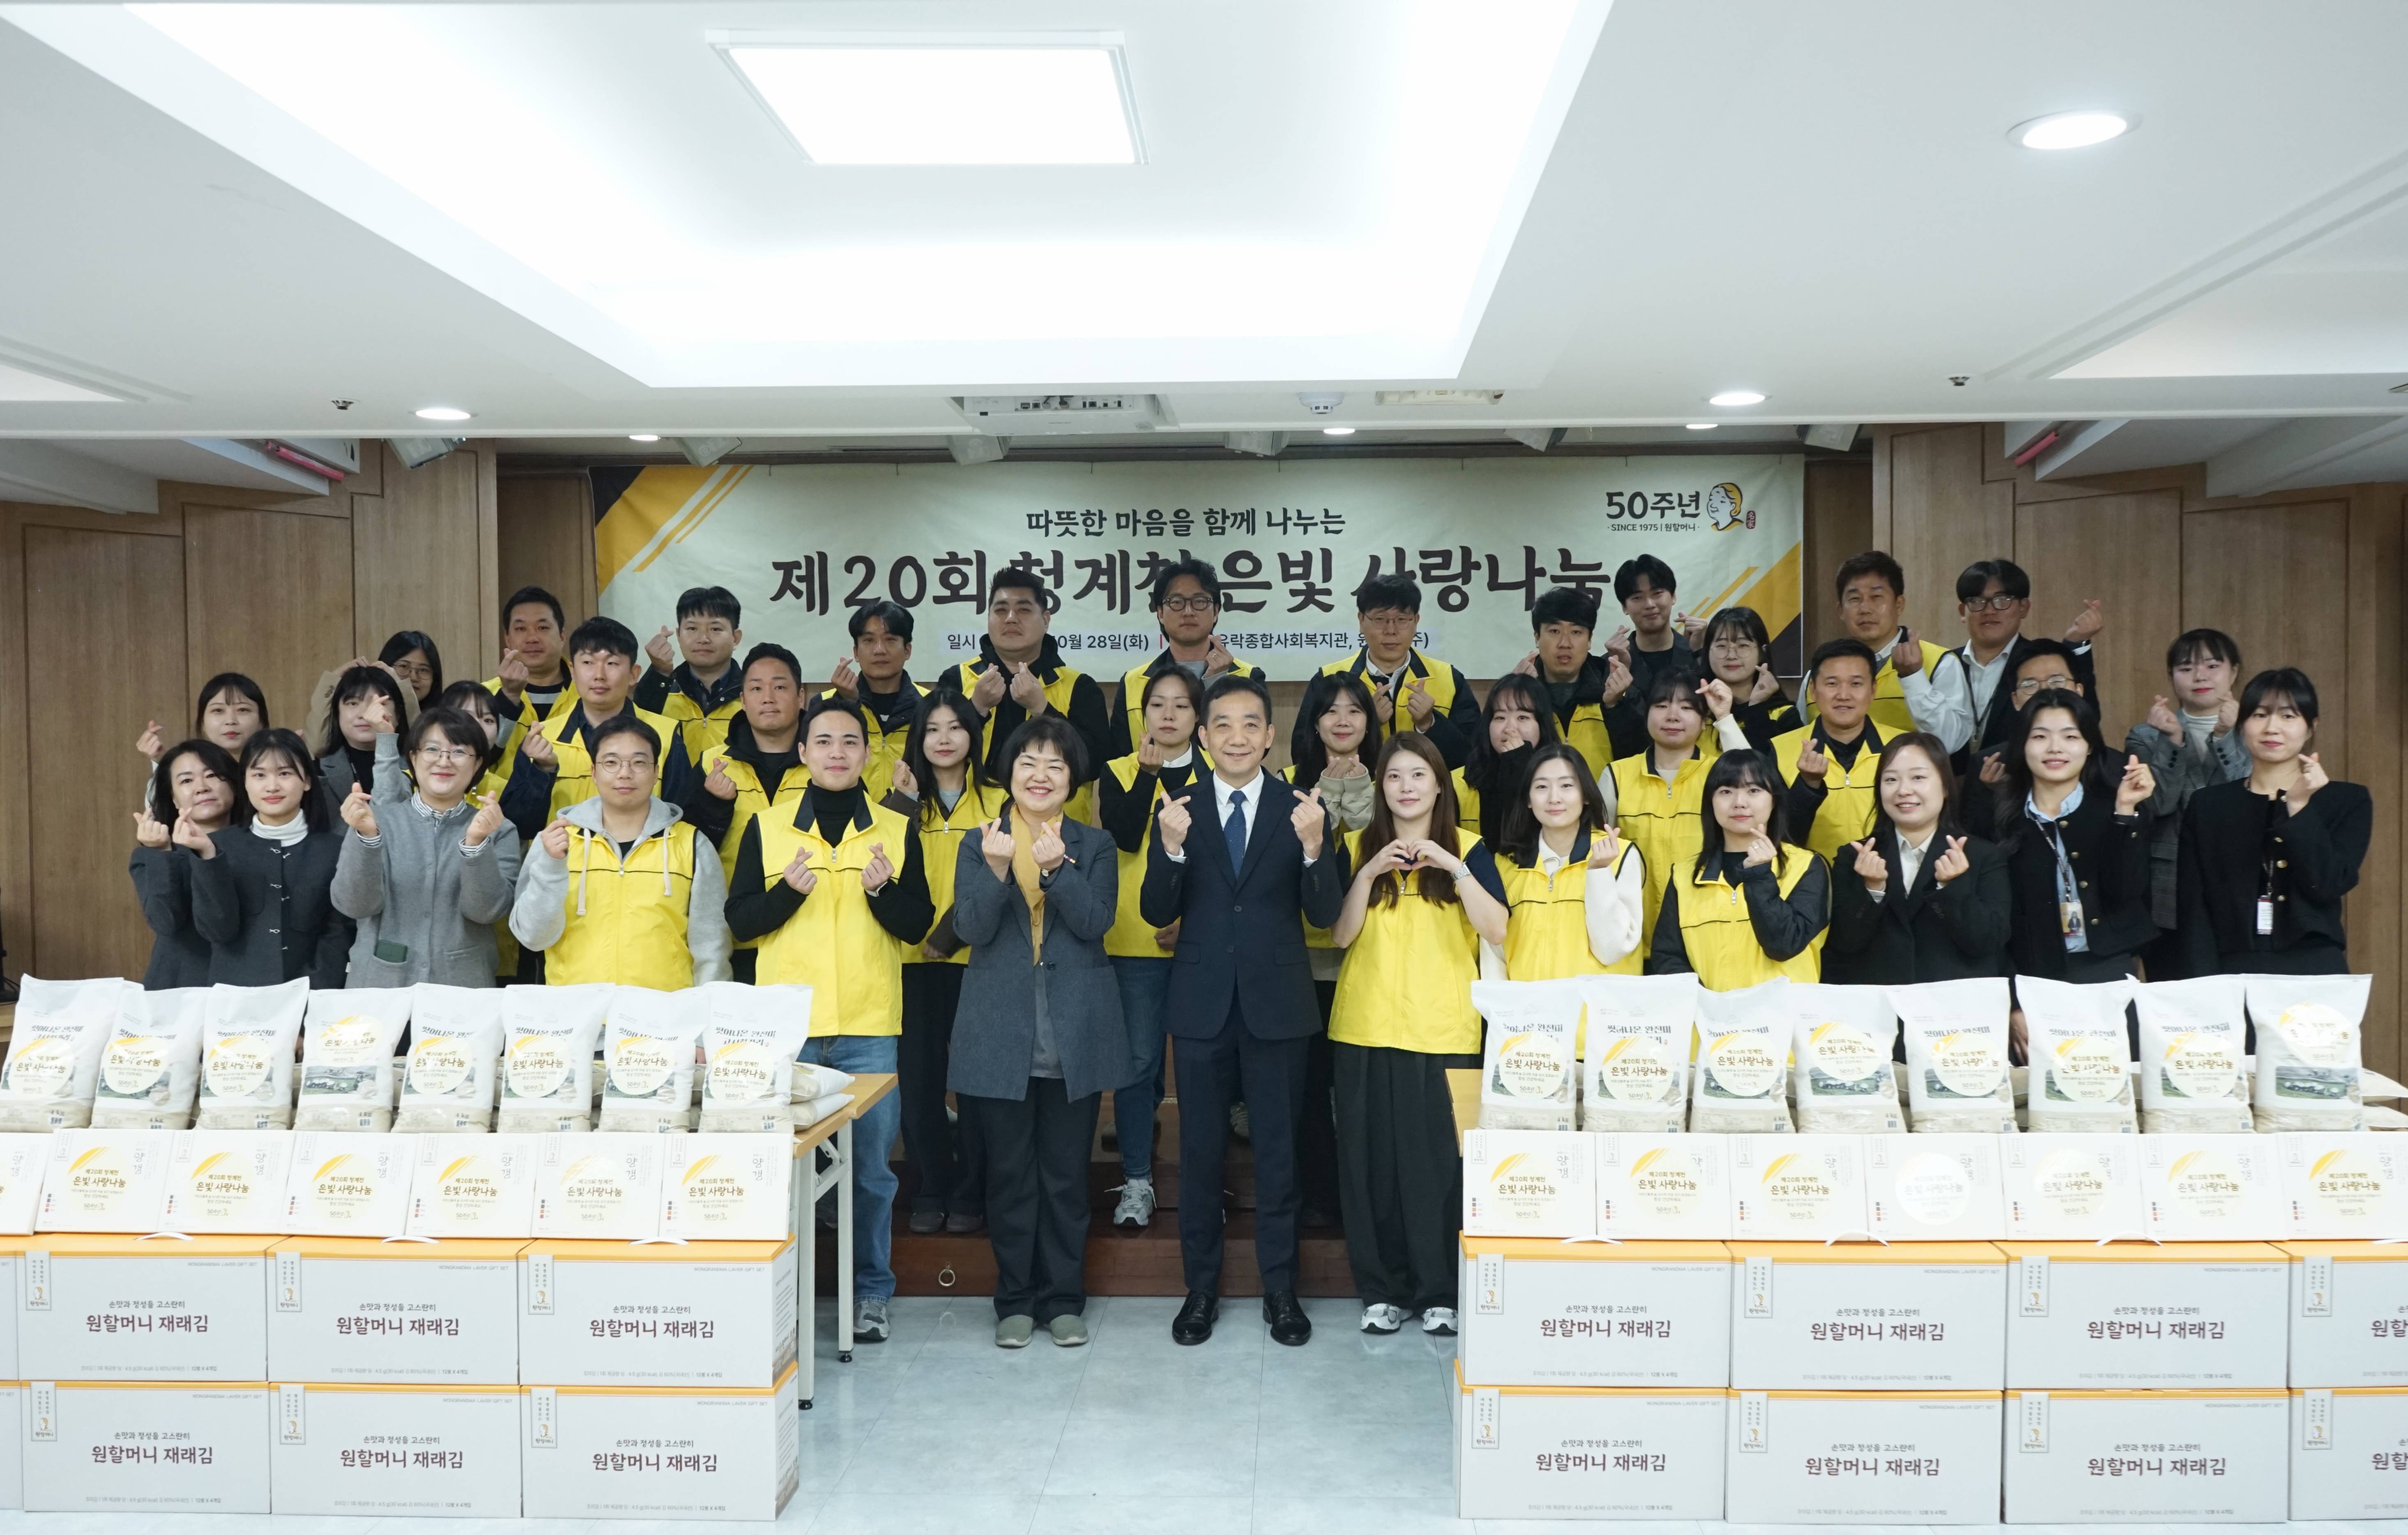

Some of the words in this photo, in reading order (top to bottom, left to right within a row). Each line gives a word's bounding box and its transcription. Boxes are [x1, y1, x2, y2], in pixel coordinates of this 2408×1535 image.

[1606, 490, 1700, 519] 50주년
[1026, 509, 1107, 537] 따뜻한
[1115, 508, 1195, 537] 마음을
[1202, 508, 1256, 536] 함께
[1266, 507, 1346, 536] 나누는
[1664, 523, 1695, 532] 원할머니
[769, 549, 987, 615] 제20회
[1218, 548, 1335, 614] 은빛
[947, 634, 975, 650] 일시
[1087, 634, 1149, 651] 28일(화)
[1644, 1025, 1671, 1033] 완전미
[512, 1060, 527, 1070] 은빛
[528, 1059, 564, 1069] 사랑나눔
[617, 1056, 632, 1066] 은빛
[633, 1057, 668, 1066] 사랑나눔
[1505, 1058, 1522, 1069] 은빛
[1524, 1060, 1561, 1072] 사랑나눔
[1717, 1056, 1736, 1066] 은빛
[1738, 1056, 1774, 1066] 사랑나눔
[2197, 1059, 2233, 1070] 사랑나눔
[714, 1067, 730, 1077] 은빛
[1611, 1066, 1629, 1076] 은빛
[1631, 1066, 1668, 1077] 사랑나눔
[73, 1176, 90, 1186] 은빛
[92, 1177, 126, 1188] 사랑나눔
[196, 1182, 213, 1192] 은빛
[215, 1183, 249, 1193] 사랑나눔
[1638, 1179, 1656, 1190] 은빛
[1659, 1179, 1697, 1190] 사랑나눔
[2178, 1183, 2197, 1193] 은빛
[2201, 1182, 2240, 1192] 사랑나눔
[2318, 1181, 2338, 1192] 은빛
[2341, 1181, 2380, 1191] 사랑나눔
[318, 1184, 336, 1194] 은빛
[337, 1185, 372, 1195] 사랑나눔
[443, 1185, 461, 1196] 은빛
[463, 1186, 498, 1197] 사랑나눔
[567, 1187, 585, 1197] 은빛
[586, 1187, 622, 1197] 사랑나눔
[688, 1187, 706, 1197] 은빛
[708, 1186, 744, 1197] 사랑나눔
[1498, 1184, 1516, 1194] 은빛
[1519, 1184, 1556, 1195] 사랑나눔
[1770, 1185, 1789, 1195] 은빛
[1791, 1185, 1830, 1195] 사랑나눔
[133, 1300, 154, 1309] 정성을
[157, 1300, 185, 1309] 고스란히
[359, 1303, 381, 1311] 손맛과
[383, 1303, 405, 1312] 정성을
[612, 1305, 635, 1314] 손맛과
[637, 1305, 659, 1314] 정성을
[661, 1306, 691, 1314] 고스란히
[1565, 1305, 1589, 1313] 손맛과
[1591, 1305, 1614, 1314] 정성을
[1616, 1305, 1647, 1314] 고스란히
[1836, 1308, 1860, 1316] 손맛과
[1862, 1308, 1885, 1317] 정성을
[1888, 1309, 1920, 1317] 고스란히
[2141, 1307, 2164, 1315] 정성을
[2167, 1307, 2199, 1315] 고스란히
[86, 1314, 152, 1332] 원할머니
[159, 1314, 208, 1332] 재래김
[336, 1316, 403, 1335] 원할머니
[409, 1318, 459, 1336] 재래김
[1540, 1319, 1611, 1338] 원할머니
[1618, 1320, 1670, 1338] 재래김
[589, 1319, 656, 1338] 원할머니
[663, 1320, 714, 1339] 재래김
[1810, 1322, 1883, 1341] 원할머니
[1890, 1323, 1944, 1341] 재래김
[2087, 1321, 2161, 1339] 원할머니
[2168, 1321, 2224, 1339] 재래김
[114, 1431, 136, 1440] 손맛과
[138, 1432, 159, 1440] 정성을
[363, 1436, 385, 1444] 손맛과
[387, 1436, 409, 1444] 정성을
[411, 1436, 440, 1445] 고스란히
[640, 1439, 662, 1448] 정성을
[664, 1440, 694, 1448] 고스란히
[1561, 1439, 1584, 1448] 손맛과
[1586, 1439, 1609, 1448] 정성을
[1611, 1440, 1642, 1448] 고스란히
[1831, 1443, 1855, 1452] 손맛과
[1858, 1443, 1881, 1452] 정성을
[1883, 1444, 1915, 1452] 고스란히
[2114, 1444, 2139, 1452] 손맛과
[2141, 1443, 2165, 1452] 정성을
[92, 1445, 157, 1464] 원할머니
[163, 1446, 212, 1464] 재래김
[340, 1449, 406, 1468] 원할머니
[413, 1450, 463, 1469] 재래김
[592, 1452, 660, 1472] 원할머니
[666, 1454, 717, 1472] 재래김
[1536, 1453, 1606, 1472] 원할머니
[1613, 1454, 1665, 1472] 재래김
[1805, 1457, 1878, 1476] 원할머니
[1885, 1458, 1939, 1476] 재래김
[2088, 1457, 2162, 1476] 원할머니
[2169, 1457, 2226, 1476] 재래김
